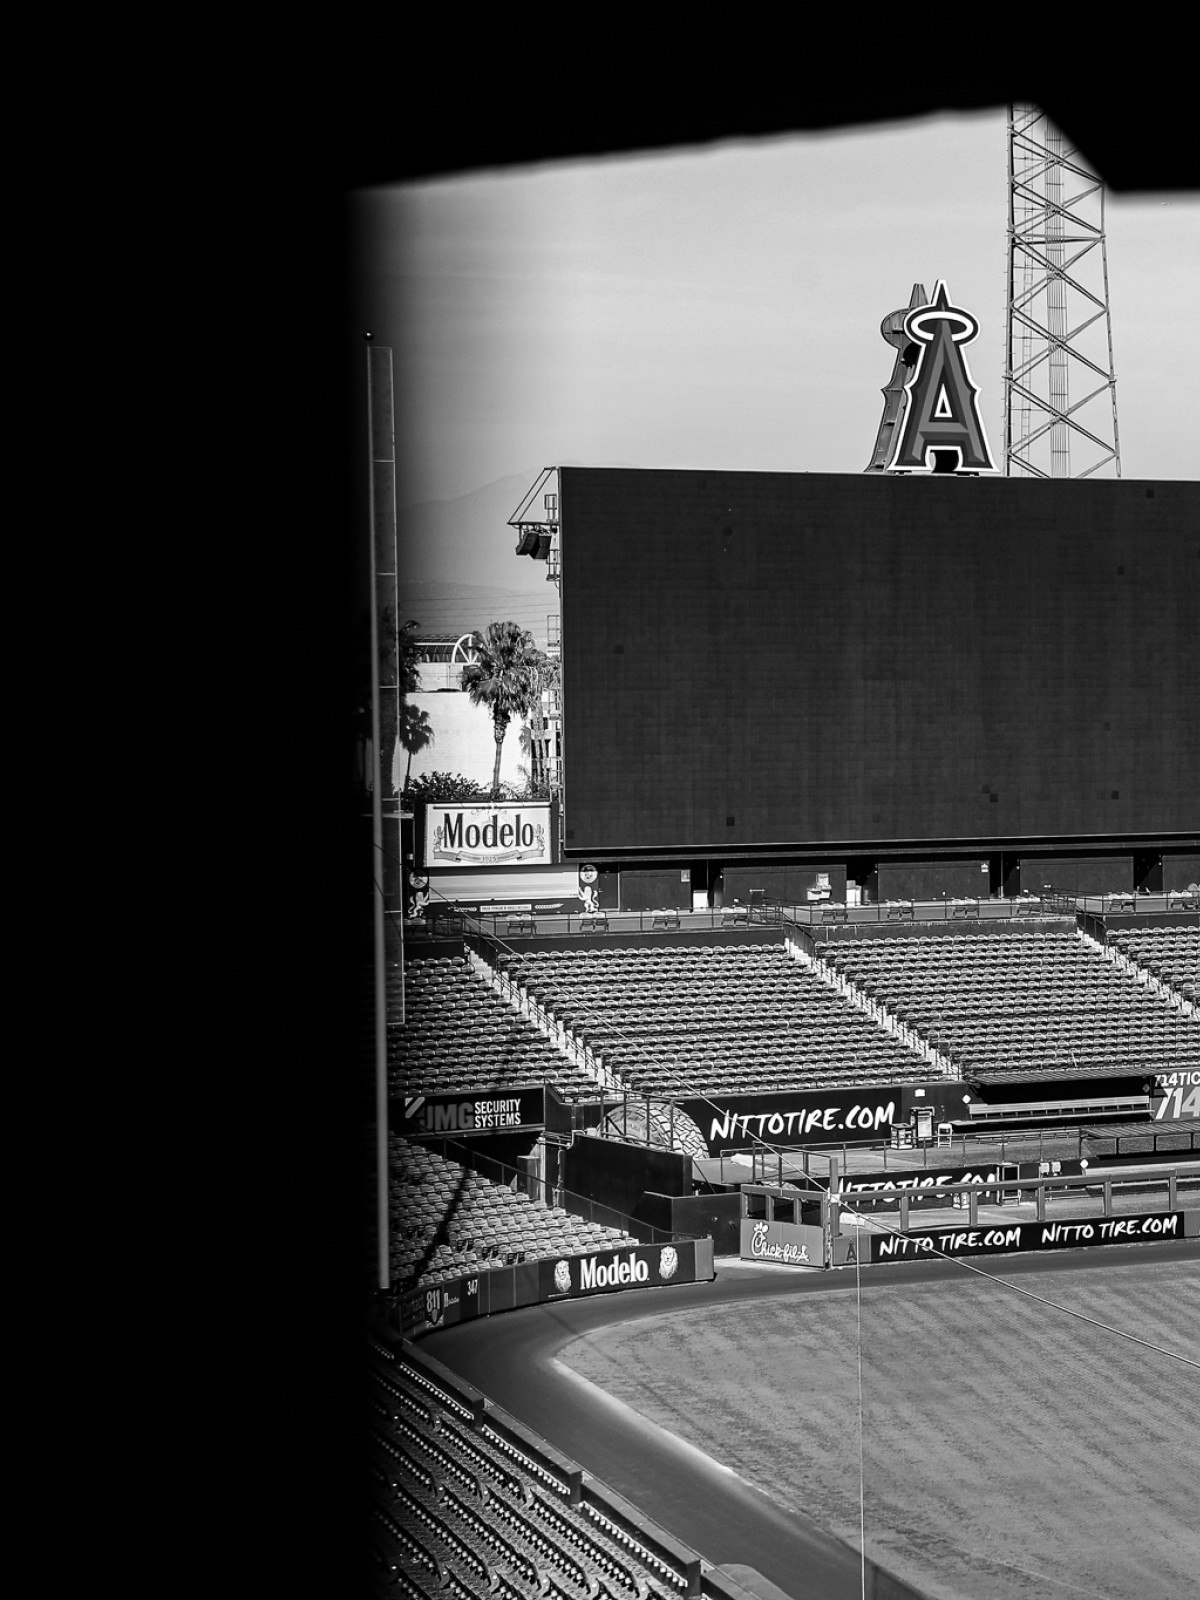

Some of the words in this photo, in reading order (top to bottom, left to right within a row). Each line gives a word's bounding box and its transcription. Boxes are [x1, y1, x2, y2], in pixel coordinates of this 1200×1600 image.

[444, 813, 534, 848] Modelo
[475, 1098, 521, 1114] SECURITY
[475, 1112, 521, 1128] SYSTEMS
[879, 1235, 933, 1256] NITTO
[939, 1227, 1021, 1250] TIRE.COM
[1042, 1223, 1094, 1243] NITTO
[1099, 1215, 1177, 1238] TIRE.COM
[580, 1253, 649, 1290] Modelo
[426, 1289, 441, 1312] 811
